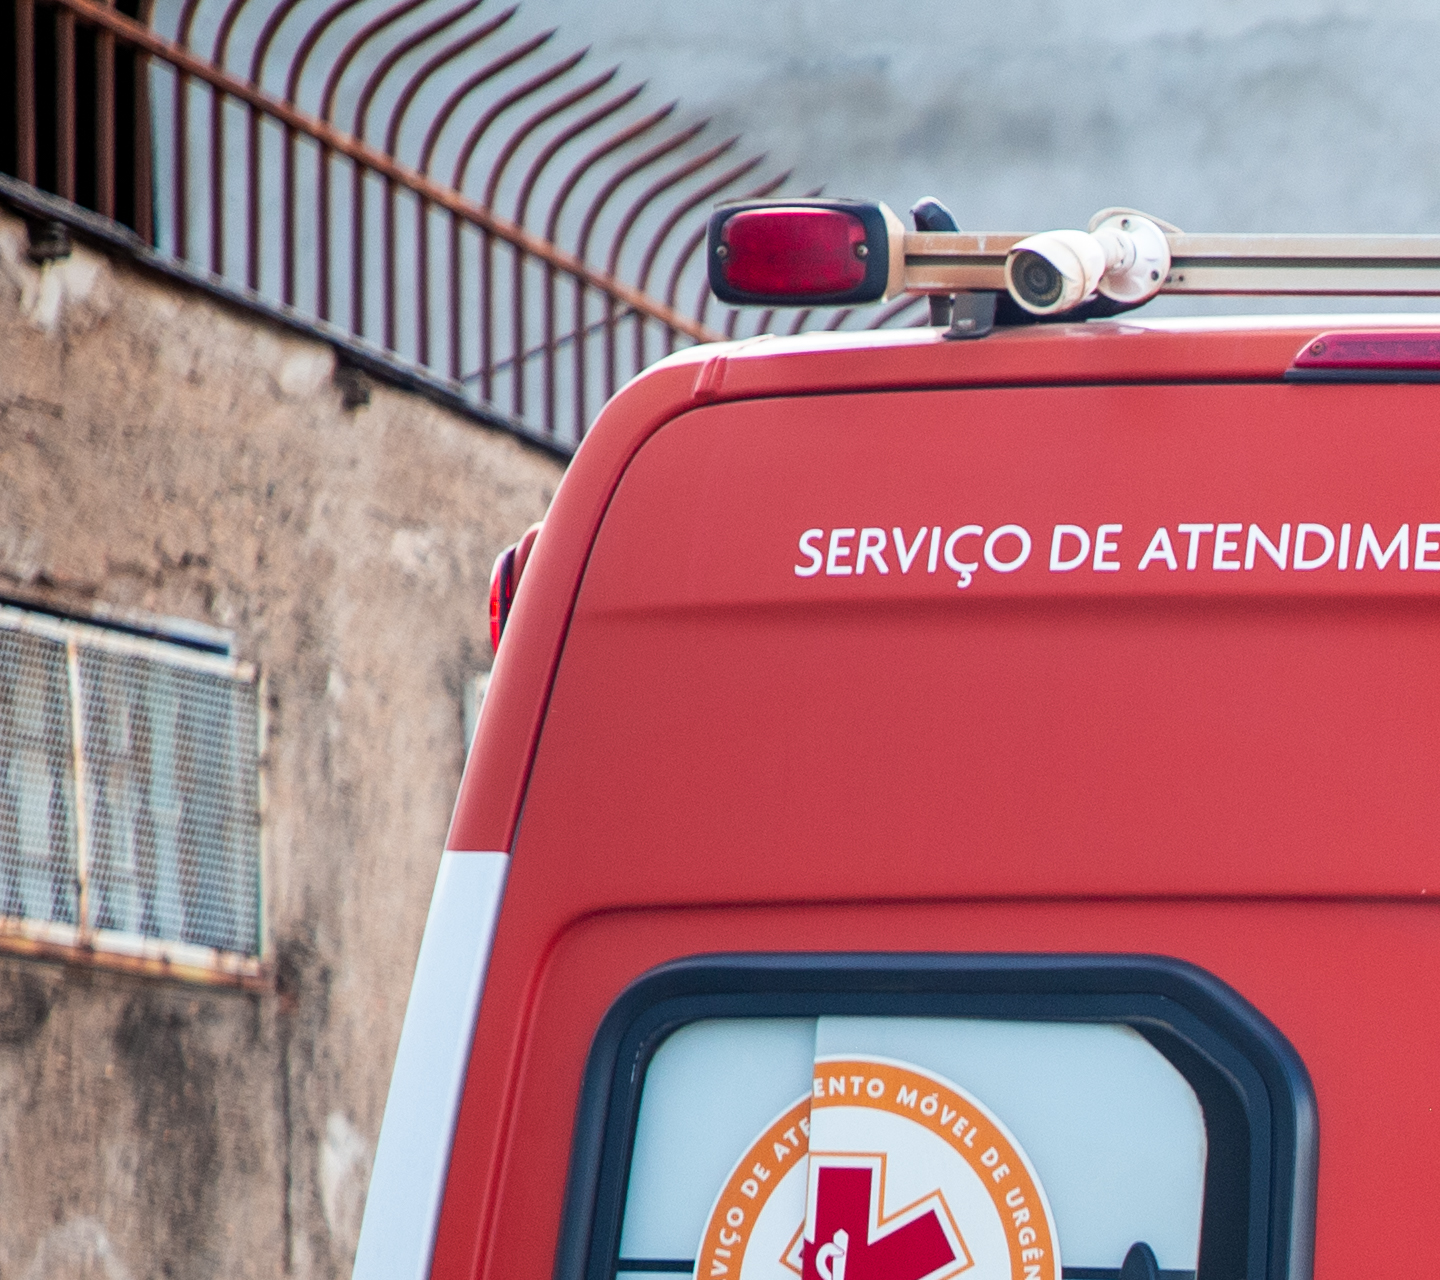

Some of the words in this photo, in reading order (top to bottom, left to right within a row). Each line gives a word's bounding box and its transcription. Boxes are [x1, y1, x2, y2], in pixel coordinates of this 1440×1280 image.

[794, 523, 1032, 588] SERVIÇO
[1049, 523, 1123, 571] DE
[740, 1162, 771, 1199] DE
[896, 1084, 977, 1148] MÓVEL
[980, 1146, 1010, 1184] DE
